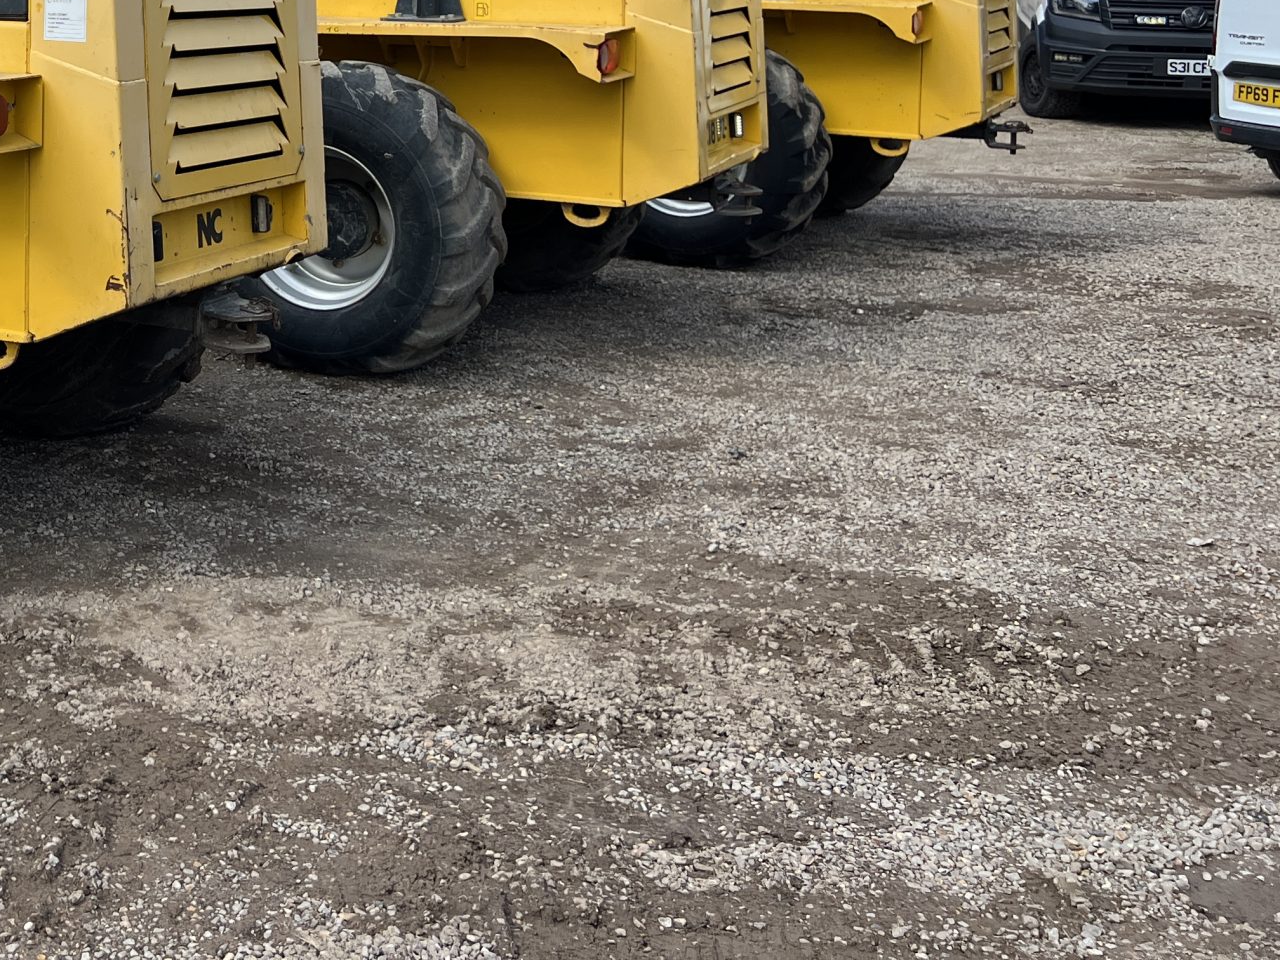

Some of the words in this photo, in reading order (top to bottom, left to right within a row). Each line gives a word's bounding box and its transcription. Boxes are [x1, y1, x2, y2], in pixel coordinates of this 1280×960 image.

[1228, 33, 1265, 41] TRANSIT
[1169, 62, 1190, 73] S31
[1238, 85, 1269, 103] FP69
[197, 208, 223, 249] NC
